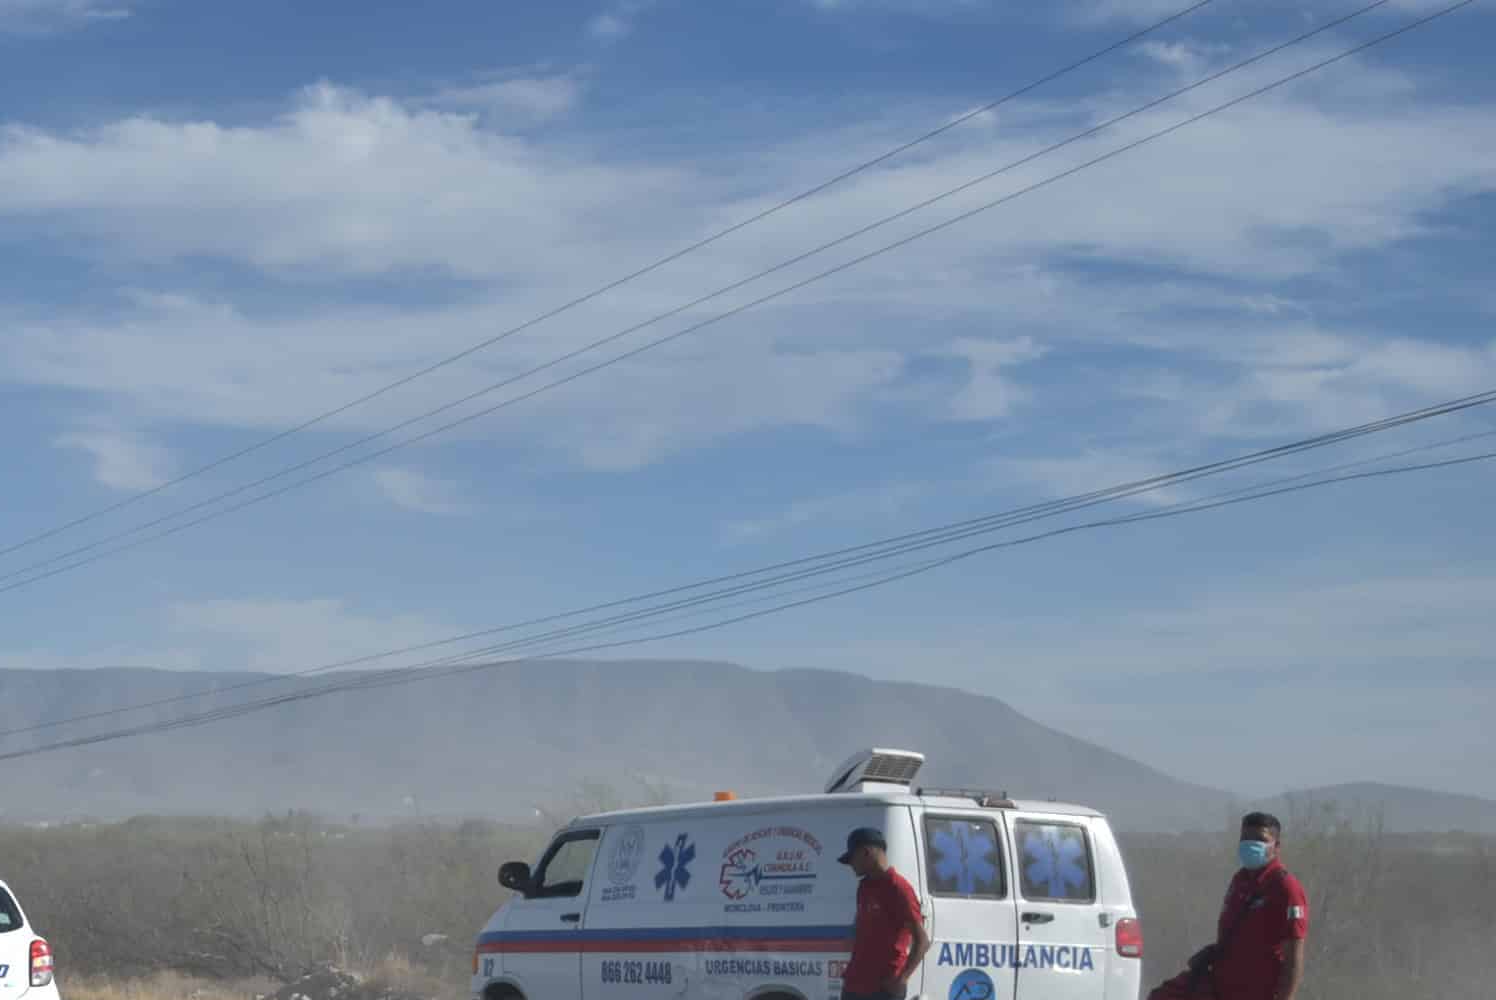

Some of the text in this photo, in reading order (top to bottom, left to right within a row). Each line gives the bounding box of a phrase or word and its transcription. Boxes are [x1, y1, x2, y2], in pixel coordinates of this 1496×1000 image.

[937, 941, 1095, 971] AMBULANCIA
[623, 961, 644, 984] 262
[705, 959, 771, 976] URGENCIAS
[773, 960, 823, 977] BASICAS
